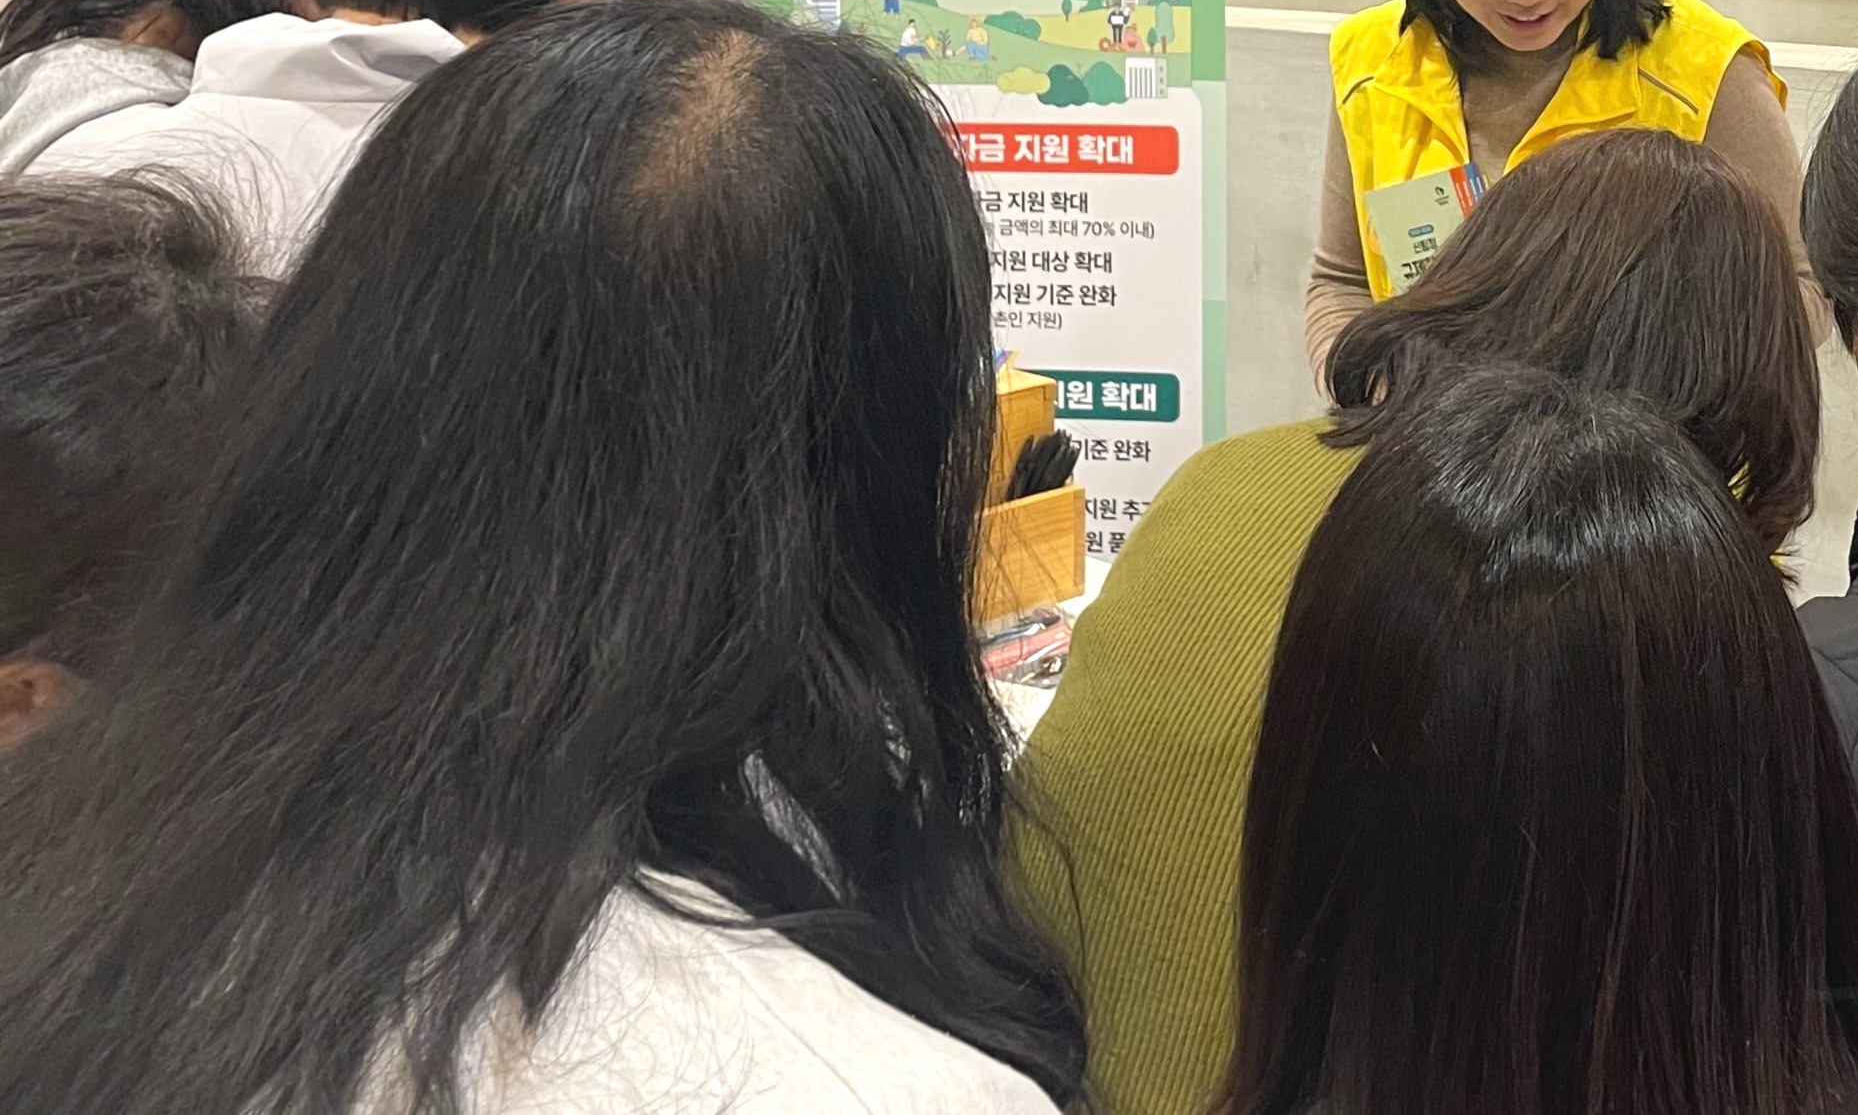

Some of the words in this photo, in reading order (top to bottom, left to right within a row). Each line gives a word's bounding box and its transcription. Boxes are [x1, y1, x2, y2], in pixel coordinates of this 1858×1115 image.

[1013, 133, 1070, 164] 지원
[1077, 134, 1134, 165] 확대
[1008, 190, 1045, 213] 지원
[1050, 191, 1089, 214] 확대
[999, 218, 1044, 237] 금액의
[1048, 219, 1078, 237] 최대
[1081, 221, 1116, 237] 70%
[1120, 220, 1155, 240] 이내)
[992, 250, 1027, 272] 지원
[1032, 250, 1070, 273] 대상
[1074, 251, 1113, 274] 확대
[993, 282, 1031, 305] 지원
[1036, 283, 1075, 306] 기준
[1079, 284, 1118, 307] 완화
[1027, 311, 1063, 331] 지원)
[1101, 380, 1158, 413] 확대
[1071, 438, 1109, 461] 기준
[1113, 439, 1152, 462] 완화
[1121, 498, 1153, 521] 추
